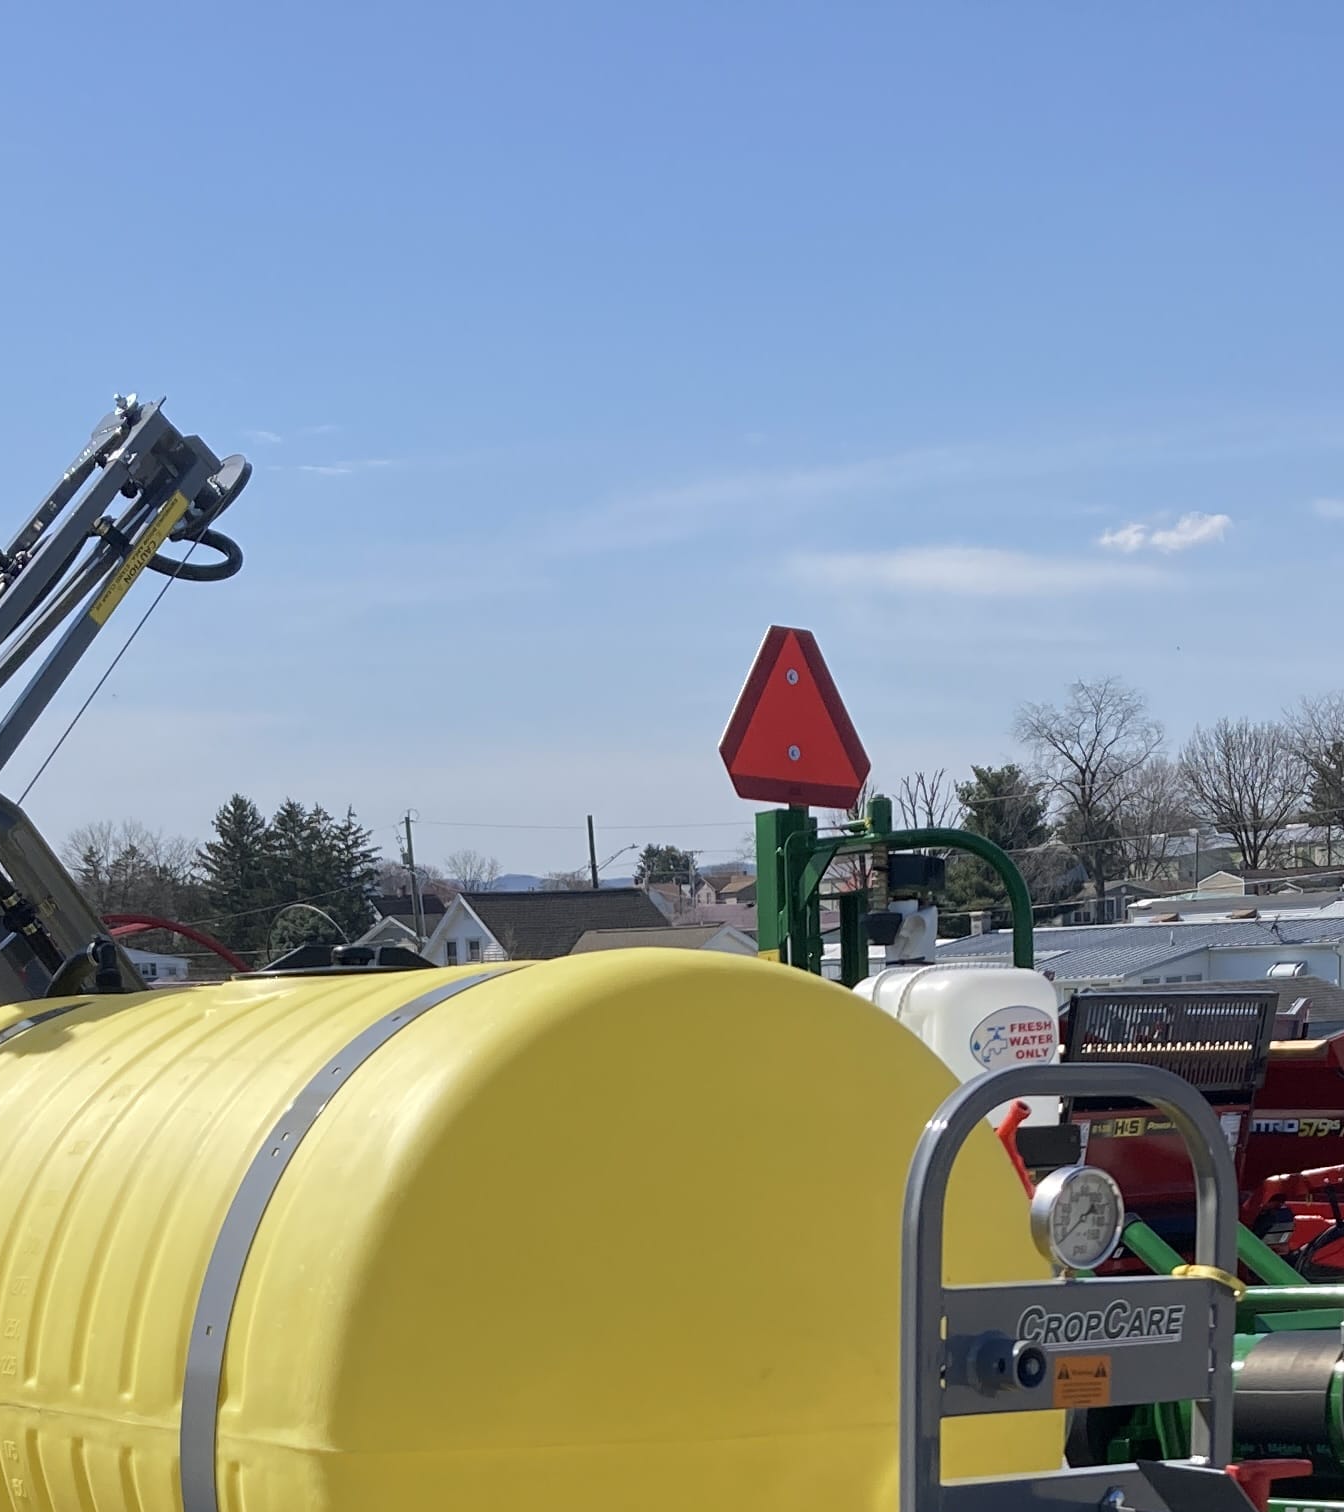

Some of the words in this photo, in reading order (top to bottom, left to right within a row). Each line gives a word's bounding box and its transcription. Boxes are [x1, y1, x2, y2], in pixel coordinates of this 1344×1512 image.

[122, 539, 157, 584] CAUTION
[1010, 1021, 1052, 1033] FRESH
[1009, 1034, 1053, 1046] WATER
[1015, 1047, 1049, 1059] ONLY
